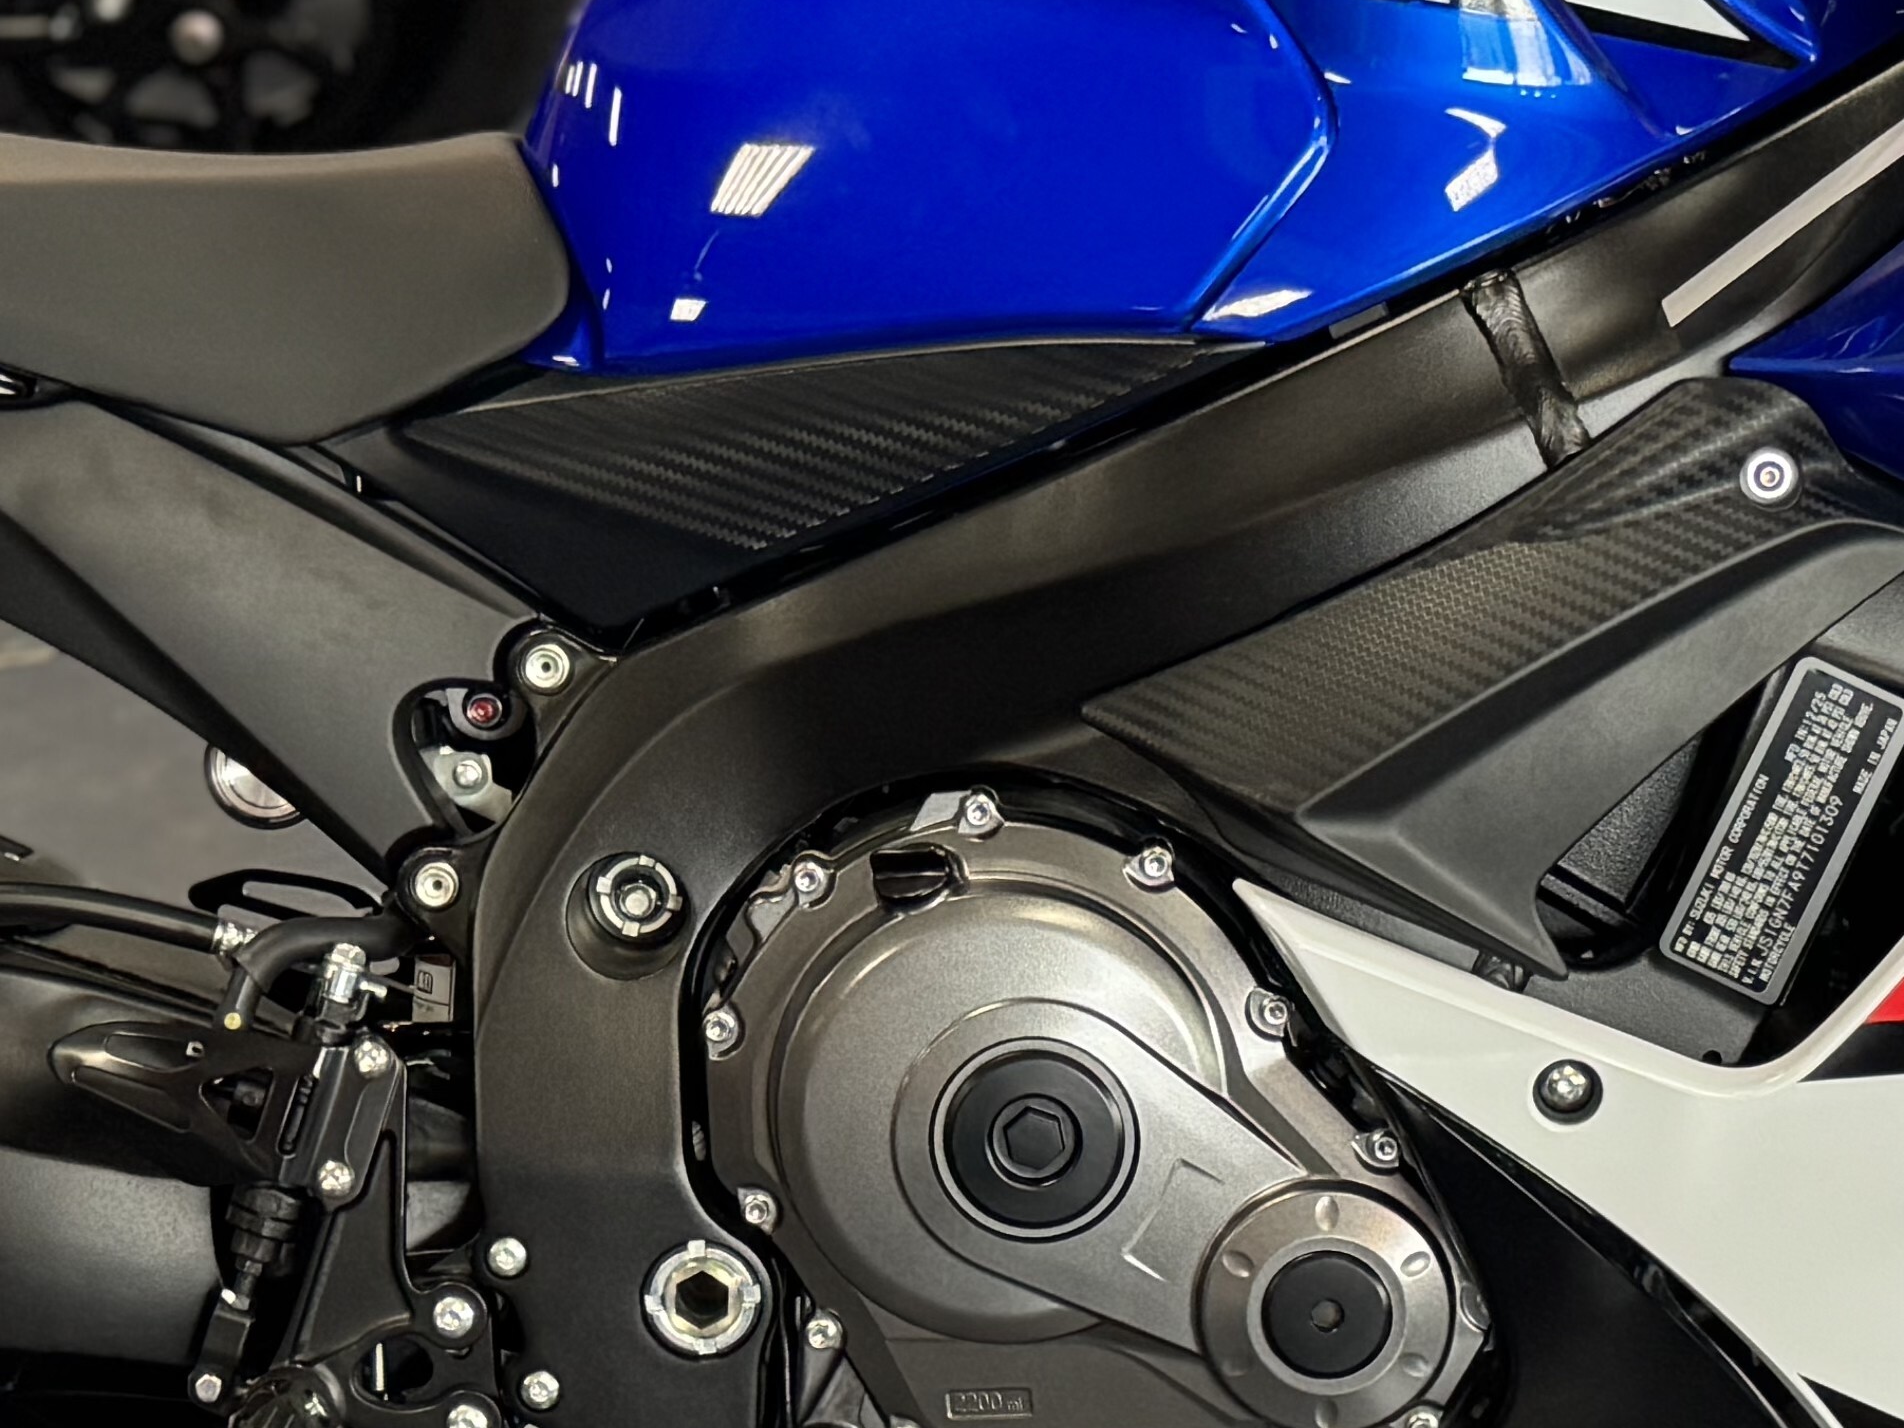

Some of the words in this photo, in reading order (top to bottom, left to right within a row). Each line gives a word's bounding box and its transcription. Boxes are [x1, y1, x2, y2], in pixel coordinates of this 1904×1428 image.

[1688, 881, 1715, 920] SUZUKI
[1708, 844, 1734, 880] MOTOR
[1726, 772, 1770, 844] CORPORATION
[1757, 921, 1796, 982] MOTORCYCLE
